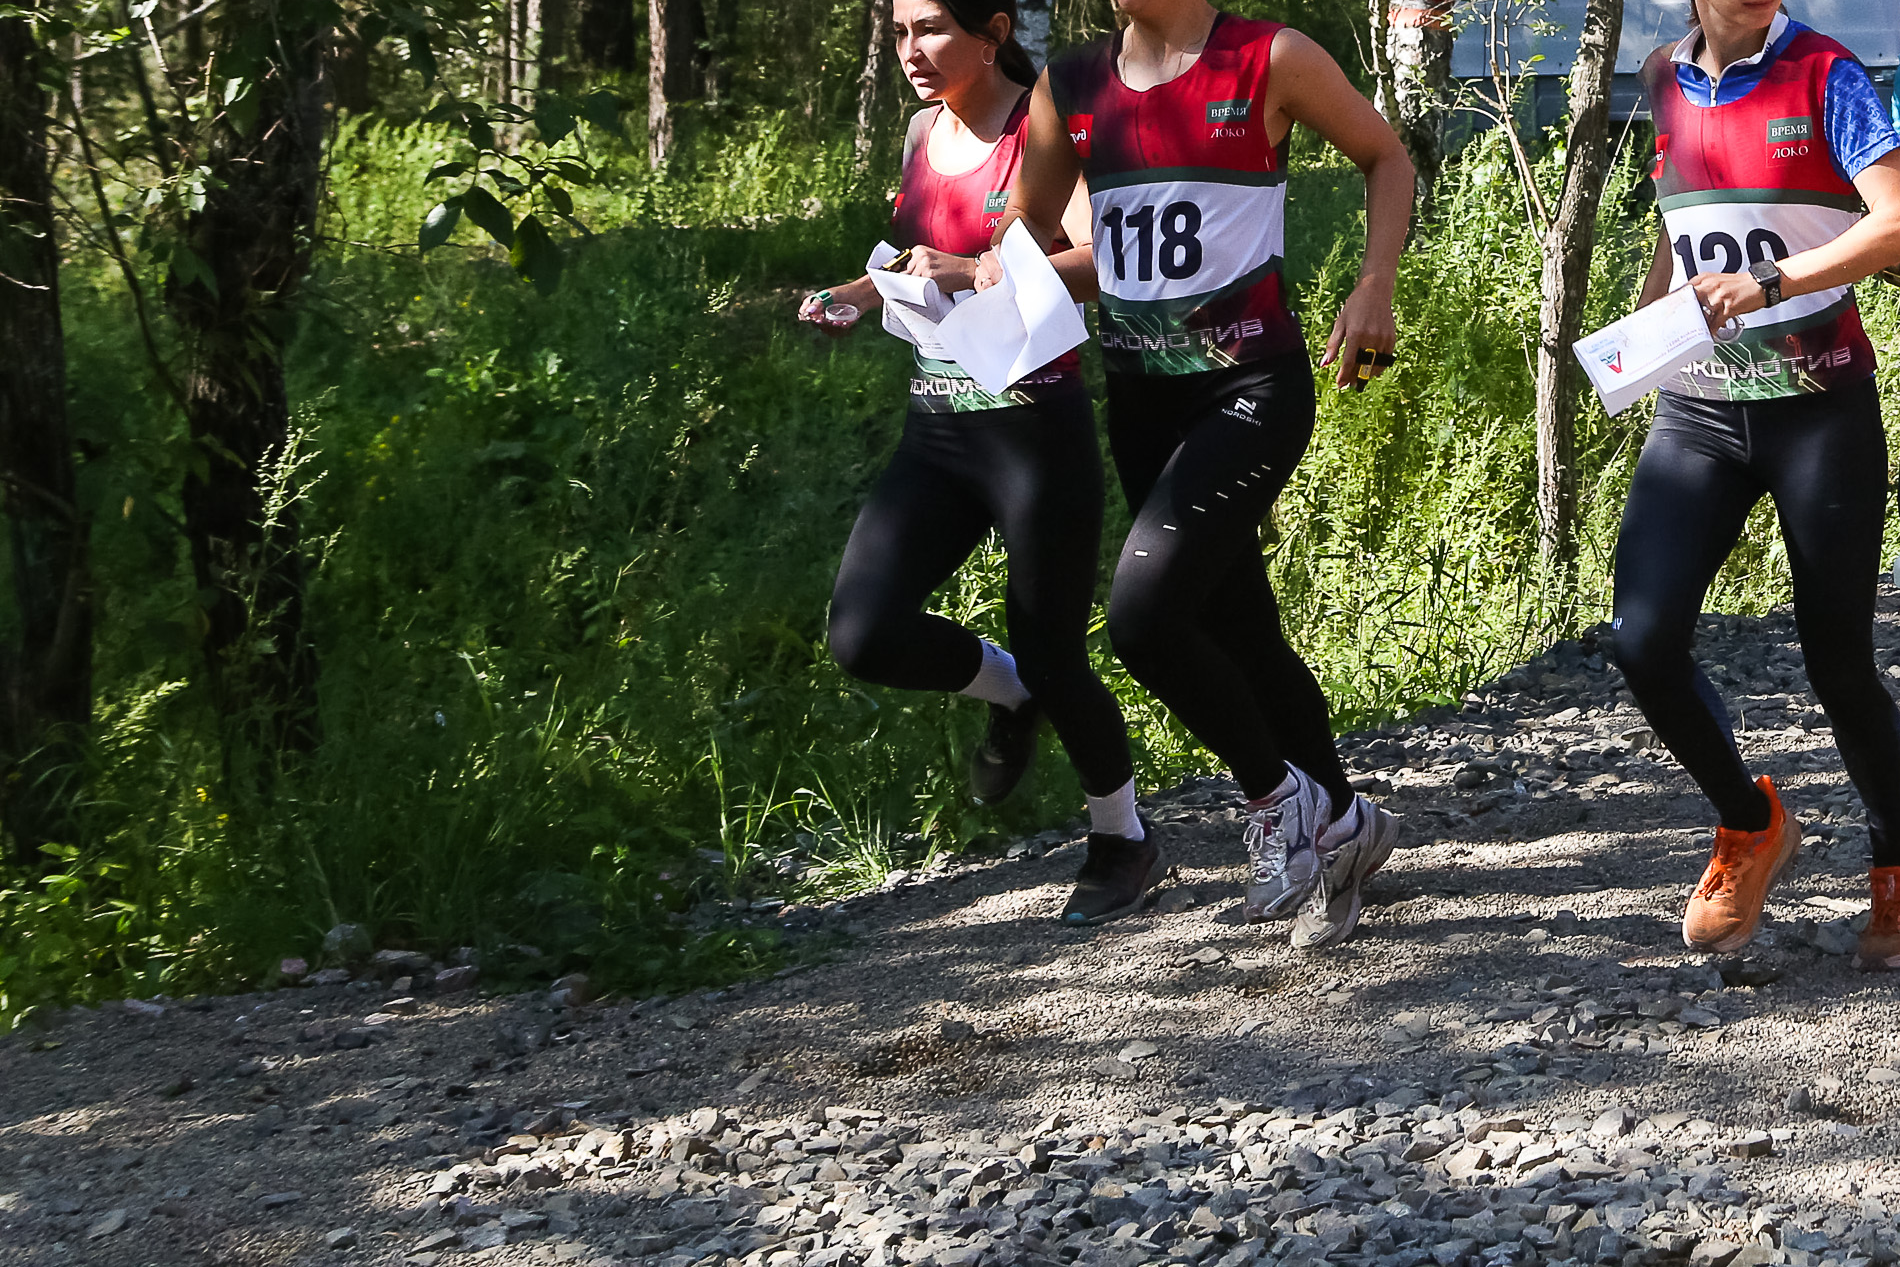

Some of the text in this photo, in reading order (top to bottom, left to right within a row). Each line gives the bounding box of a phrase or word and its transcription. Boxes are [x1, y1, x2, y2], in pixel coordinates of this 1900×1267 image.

[1210, 106, 1248, 119] ВРЕМЯ
[1210, 127, 1246, 139] ЛОКО
[1771, 123, 1808, 137] ВРЕМЯ
[1771, 145, 1809, 159] ЛОКО
[988, 197, 1008, 208] ВРЕ
[985, 217, 1003, 229] ЛО
[1100, 200, 1203, 282] 118
[1100, 318, 1264, 351] ОКОМОТИВ
[1679, 346, 1851, 380] КОМОТИВ
[1221, 407, 1262, 427] NORDSKI
